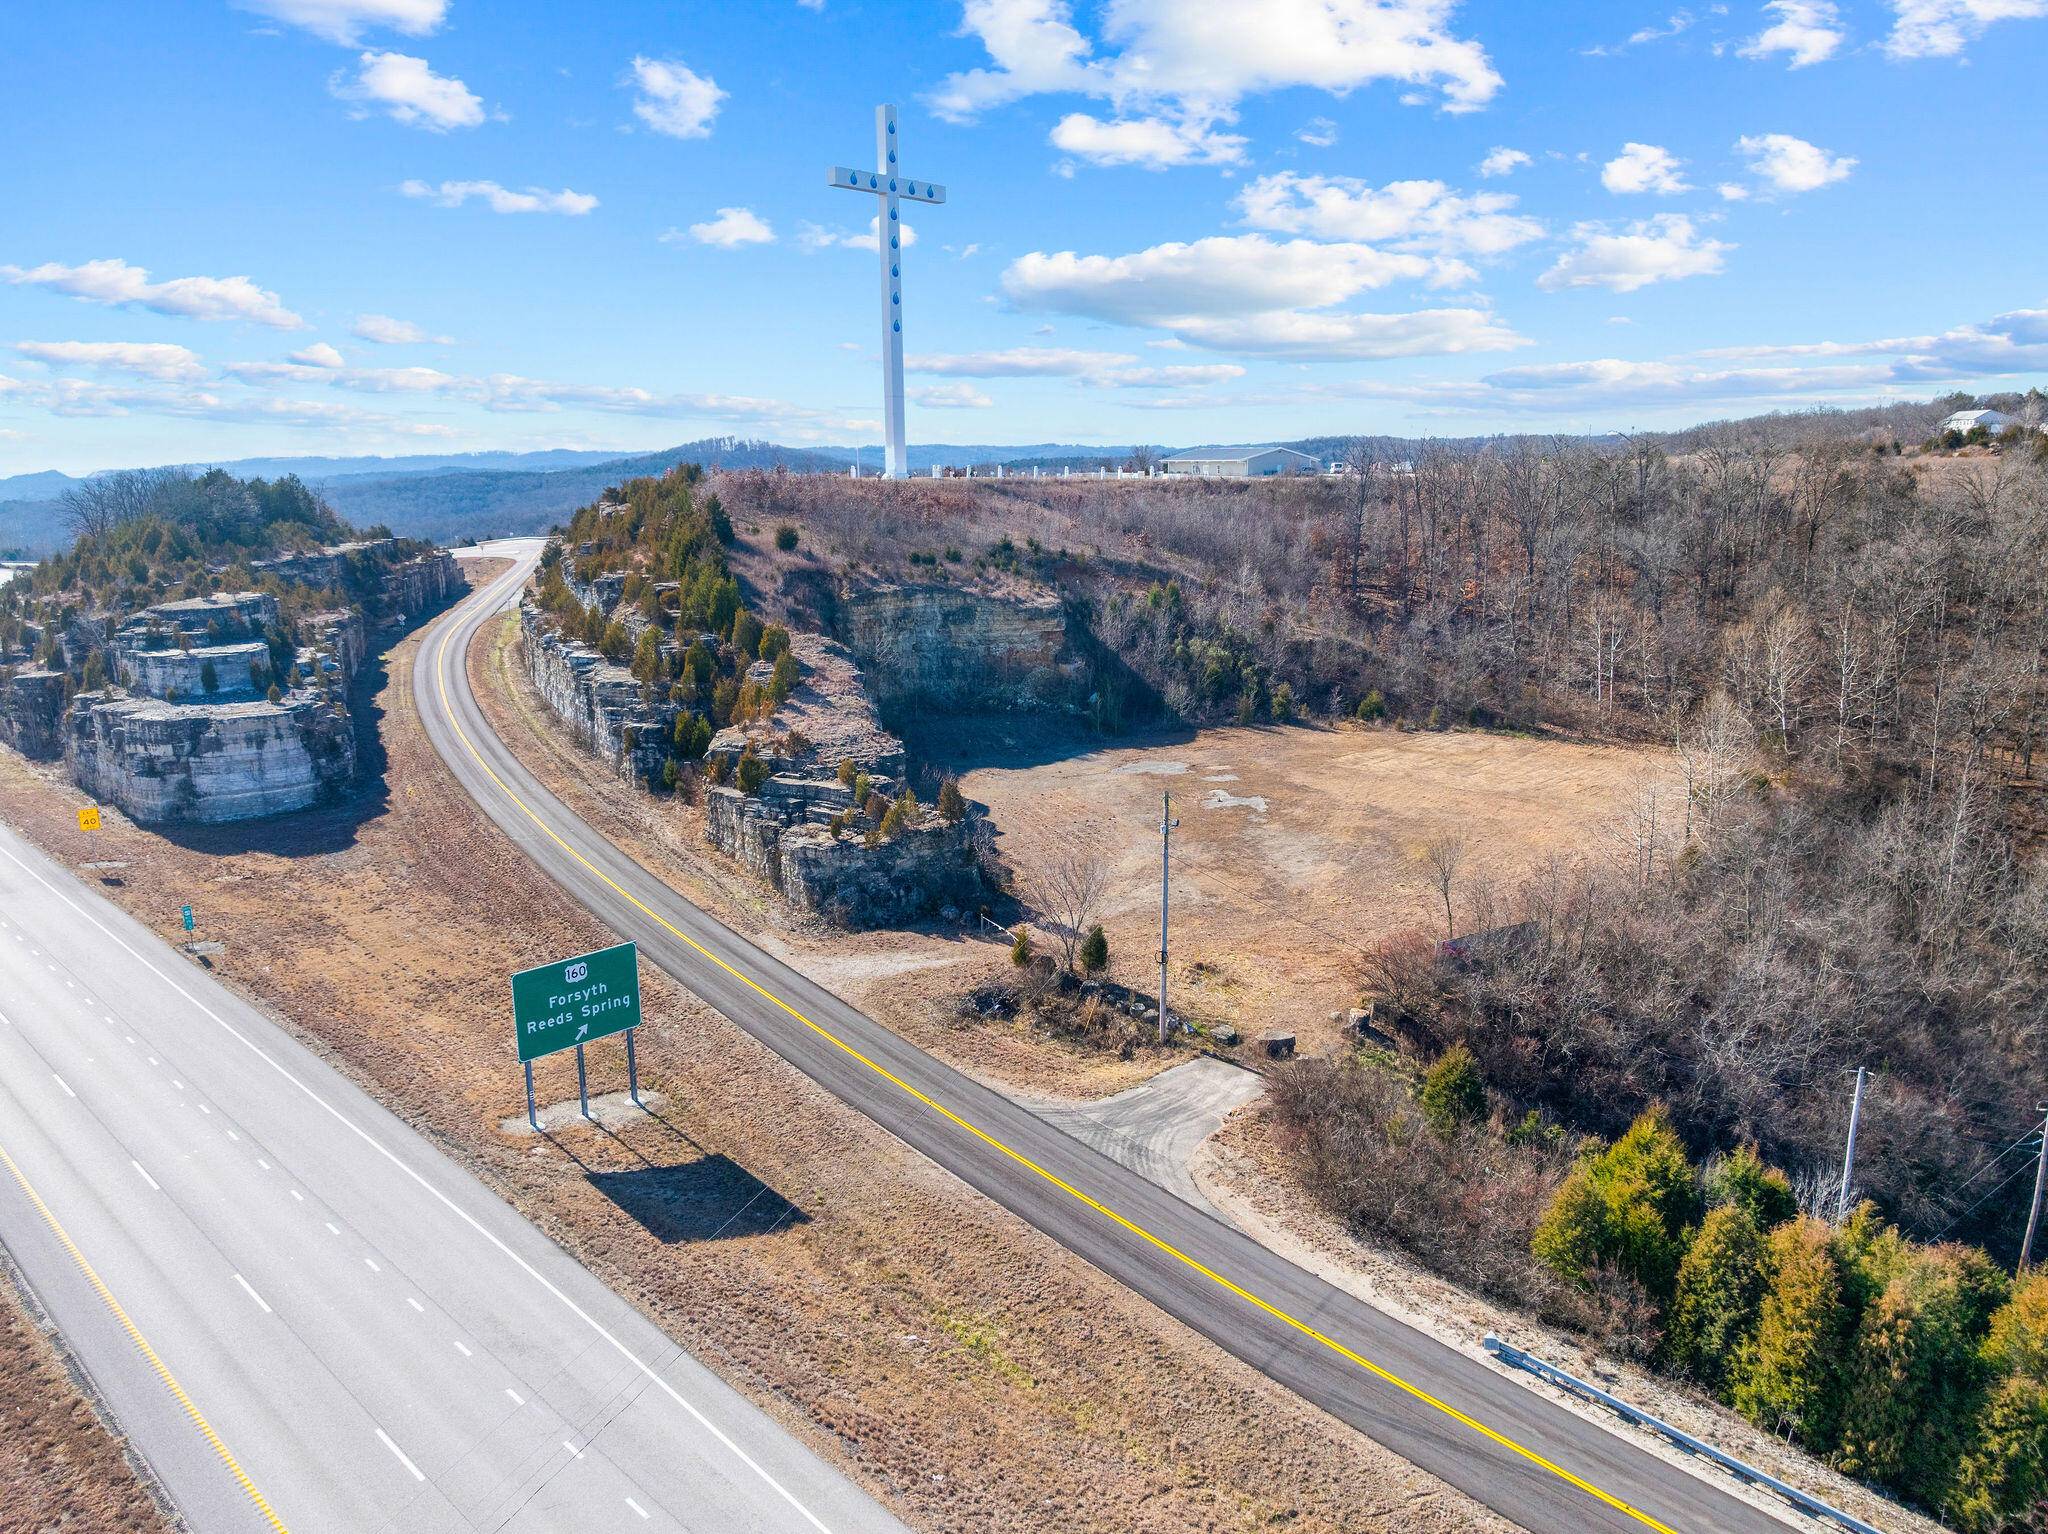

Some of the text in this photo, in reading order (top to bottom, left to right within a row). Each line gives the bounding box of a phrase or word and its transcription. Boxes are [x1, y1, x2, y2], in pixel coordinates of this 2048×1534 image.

[567, 966, 586, 980] 160
[549, 983, 607, 1008] Forsyth
[527, 995, 630, 1034] Reeds Spring
